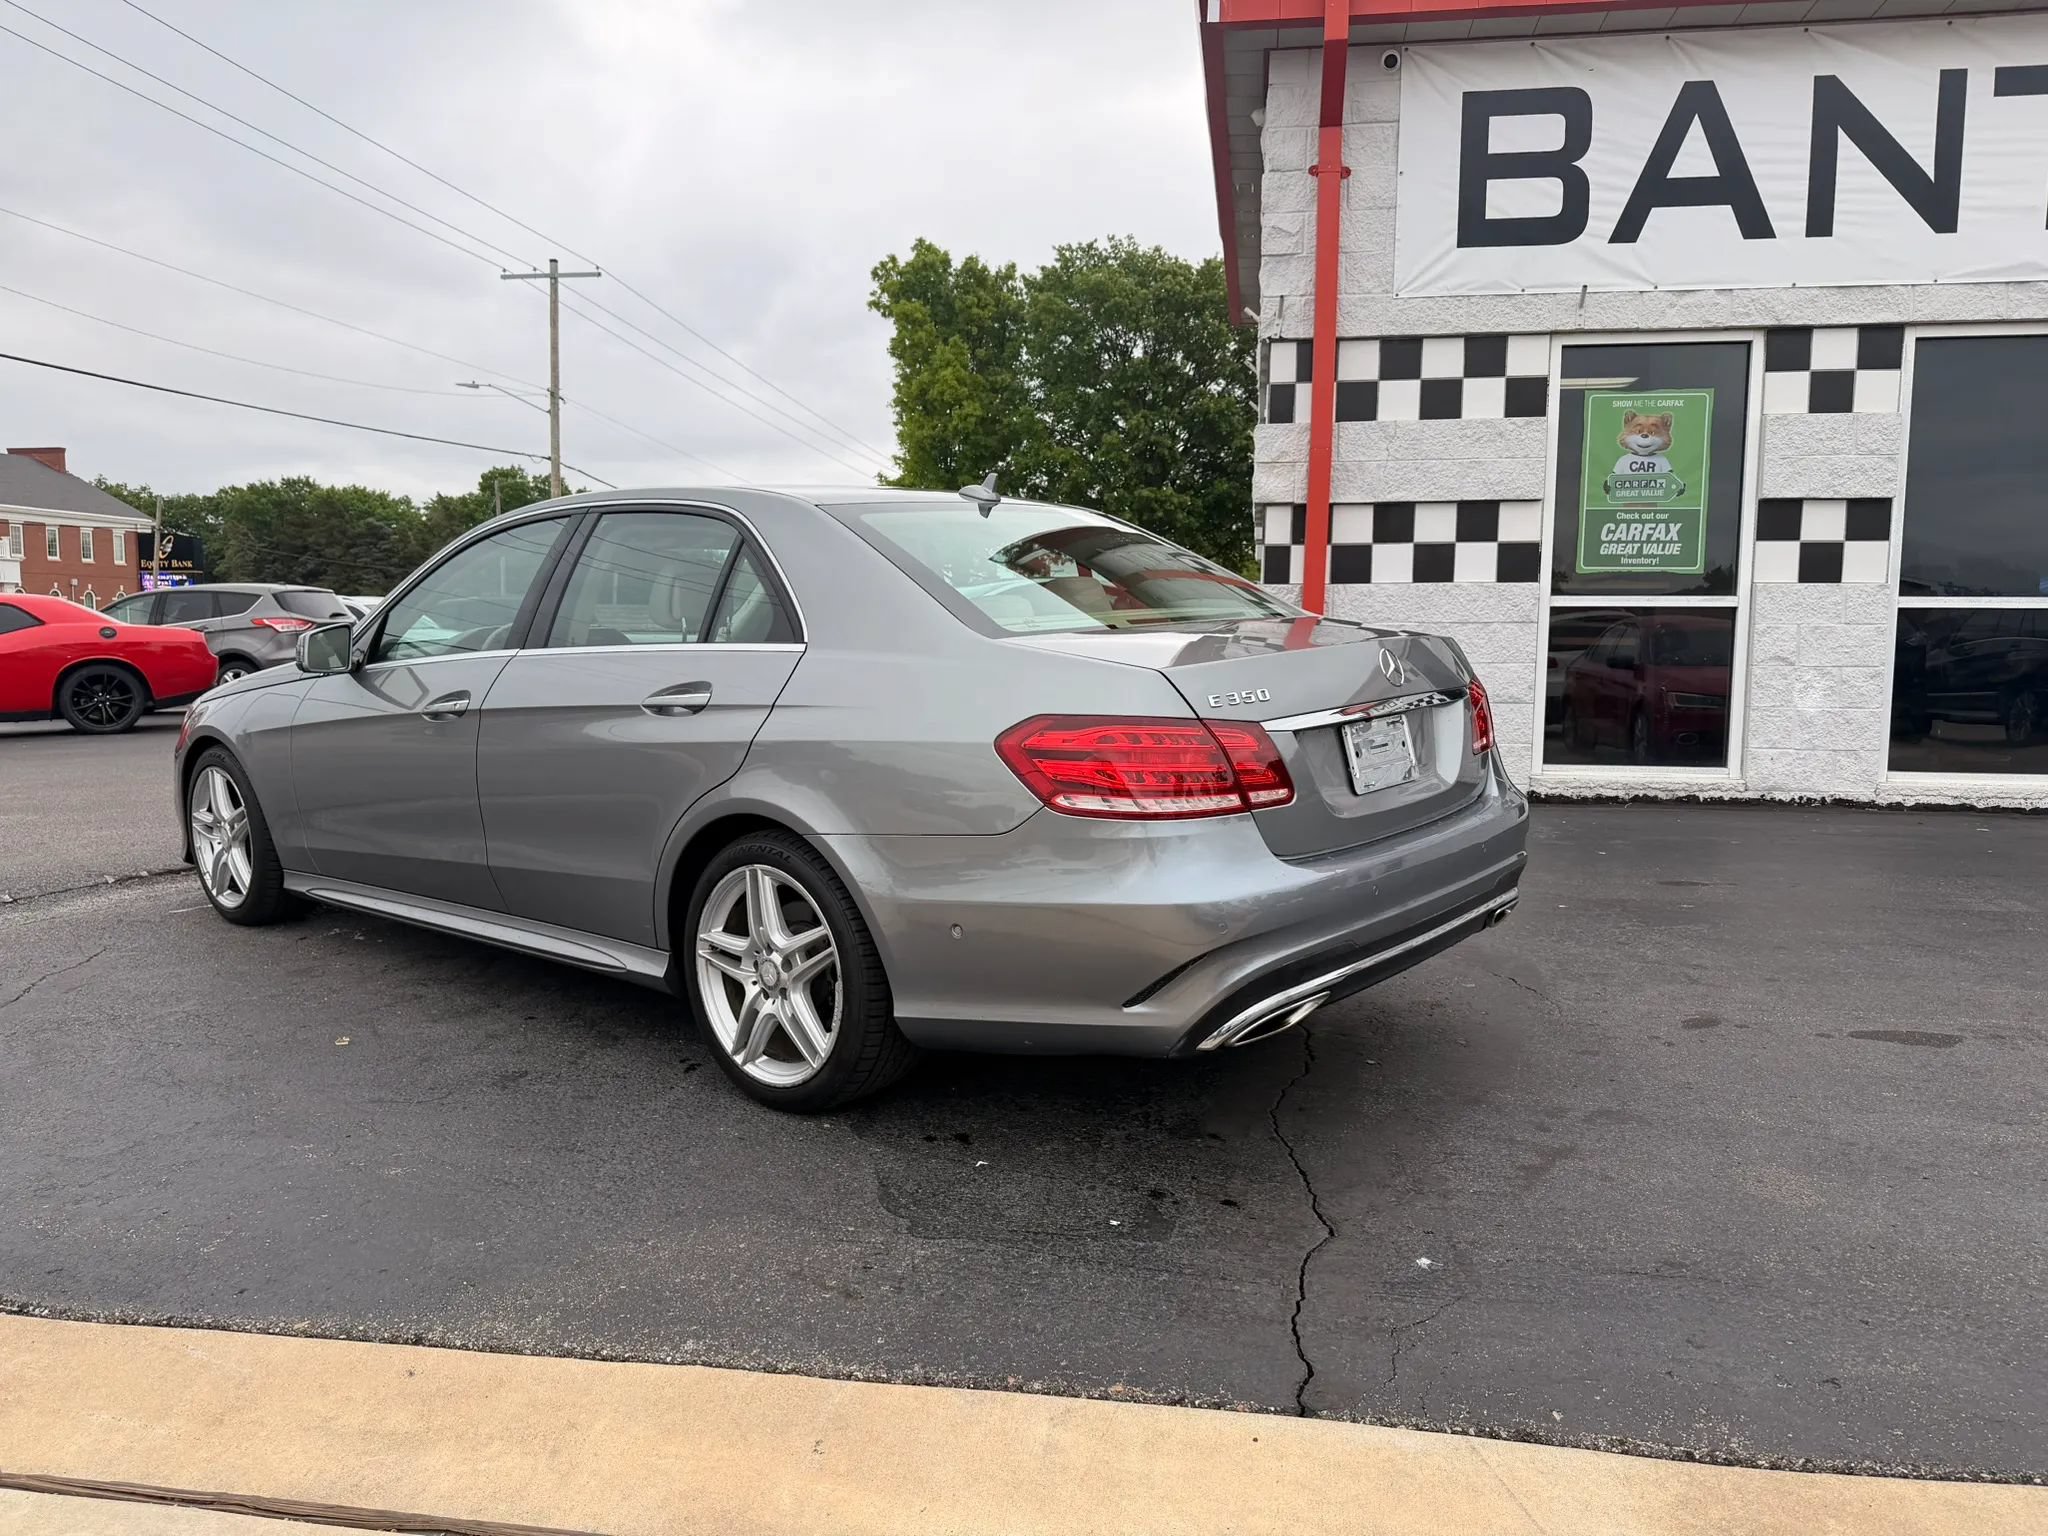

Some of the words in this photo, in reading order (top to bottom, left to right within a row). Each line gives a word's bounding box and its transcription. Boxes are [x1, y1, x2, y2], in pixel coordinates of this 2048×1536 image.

[1629, 461, 1656, 473] CAR
[1615, 480, 1665, 489] CARFAX
[1616, 489, 1639, 497] GREAT
[1641, 489, 1665, 497] VALUE
[1617, 512, 1639, 520] Check
[1600, 523, 1682, 541] CARFAX
[1600, 543, 1641, 555] GREAT
[1642, 543, 1681, 555] VALUE
[141, 560, 169, 568] EQTY
[172, 560, 193, 568] BANK
[1621, 557, 1659, 565] Inventory!
[1208, 694, 1223, 707] E
[1225, 688, 1271, 706] 350
